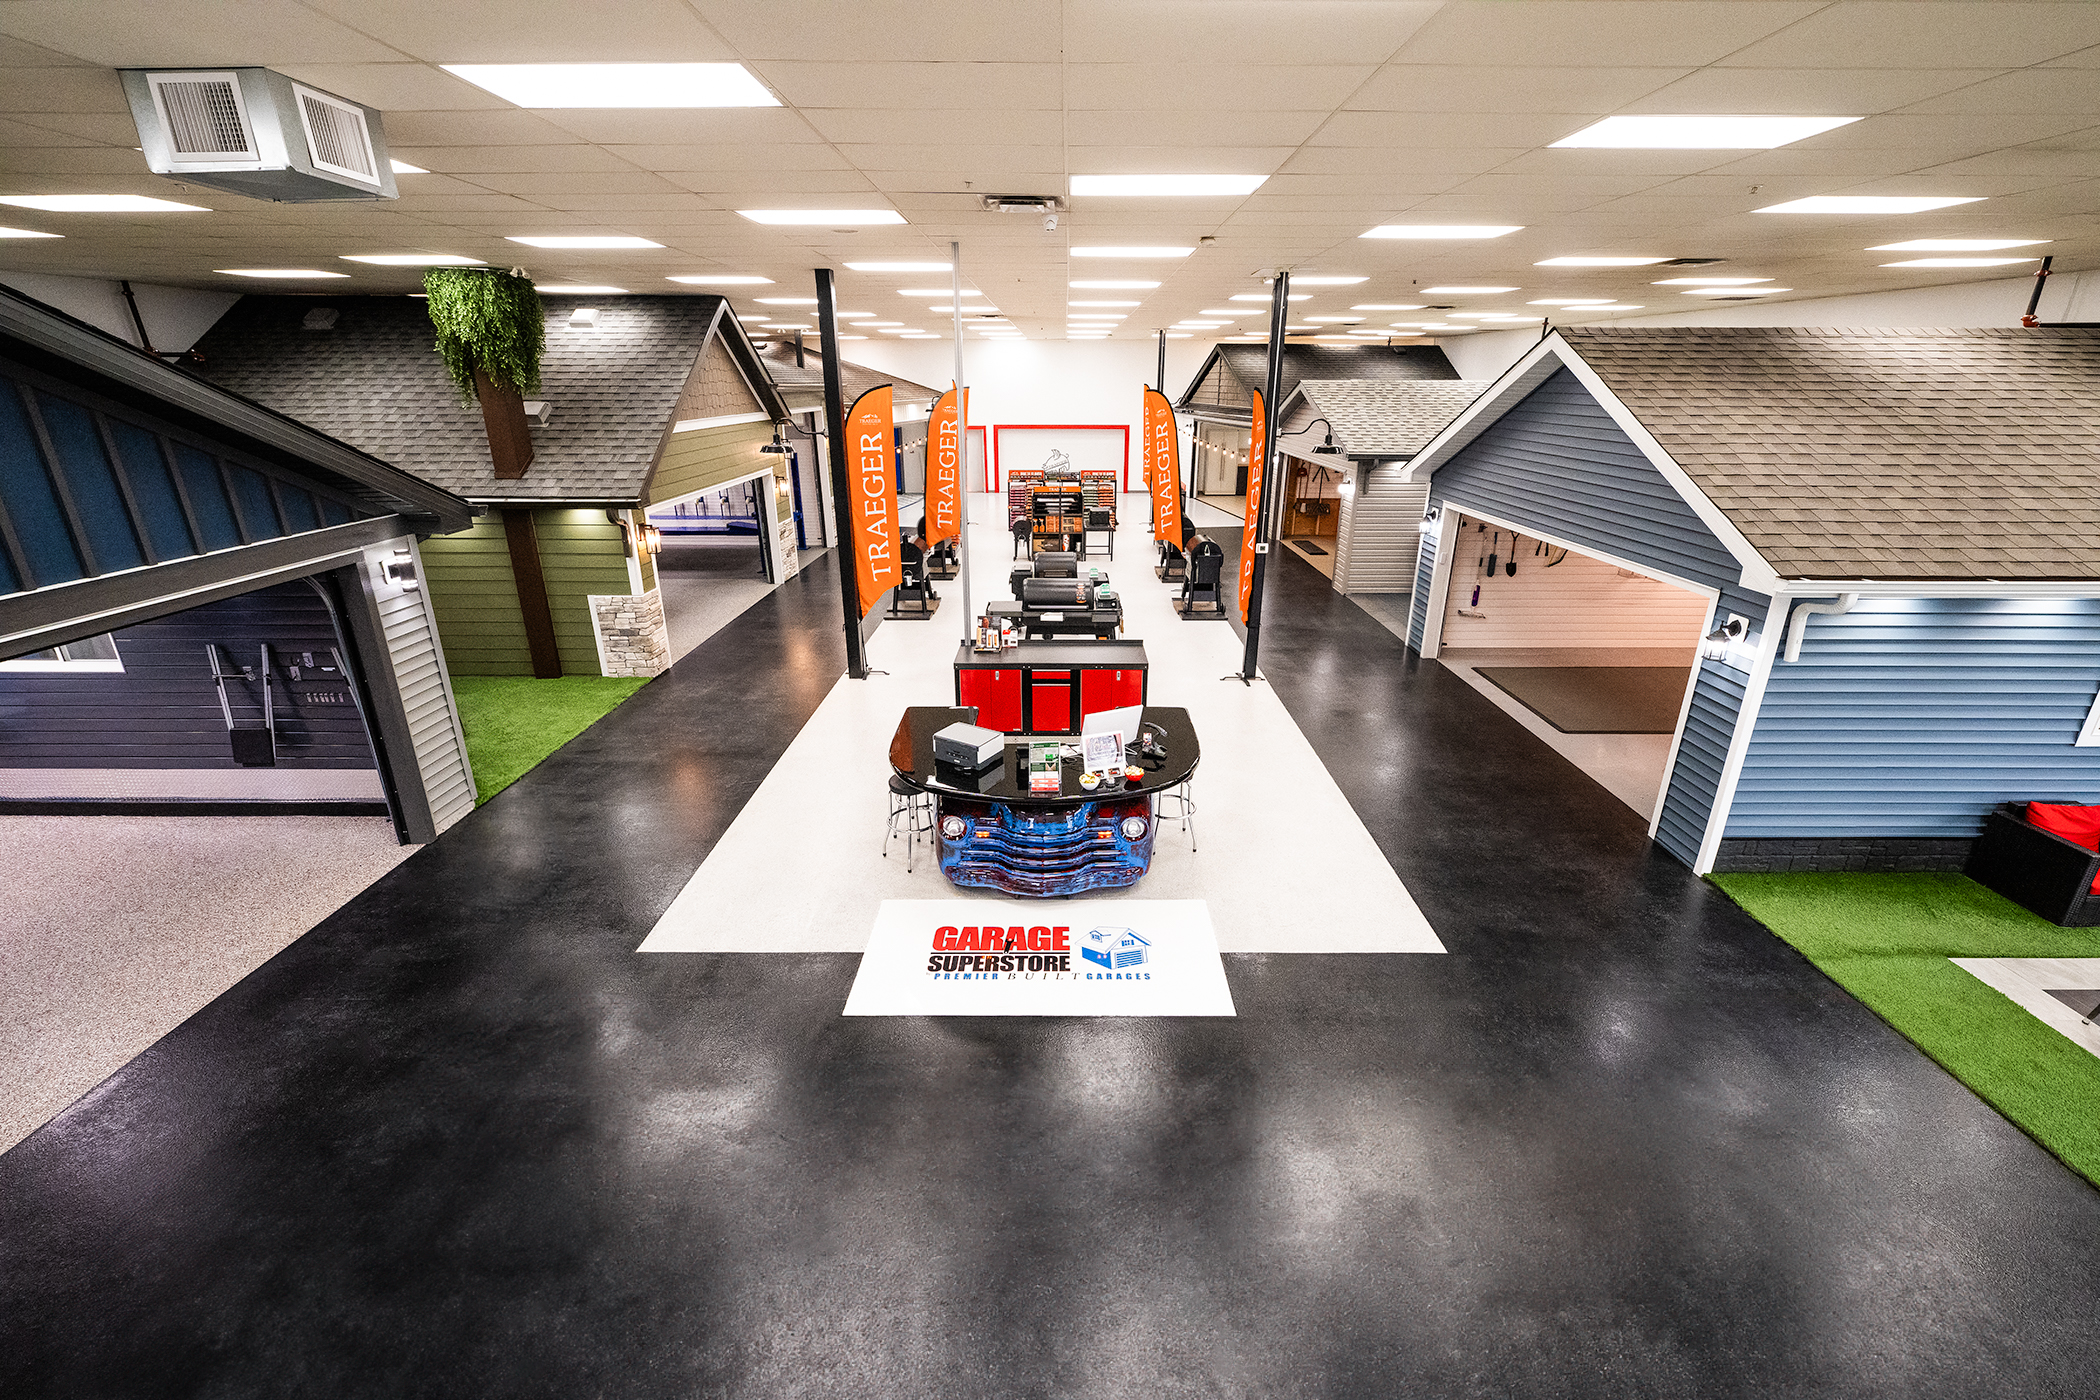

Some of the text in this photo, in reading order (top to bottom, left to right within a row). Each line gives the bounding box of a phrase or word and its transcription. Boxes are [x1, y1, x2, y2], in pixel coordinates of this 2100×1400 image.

[859, 431, 892, 582] TRAEGER
[937, 419, 958, 529] TRAEGER
[1155, 421, 1174, 533] TRAEGER
[927, 955, 1071, 972] SUPERSTORE
[932, 926, 1071, 951] GARAGE
[934, 972, 999, 981] PREMIER
[1007, 972, 1081, 981] BUILT
[1086, 972, 1151, 981] GARAGES
